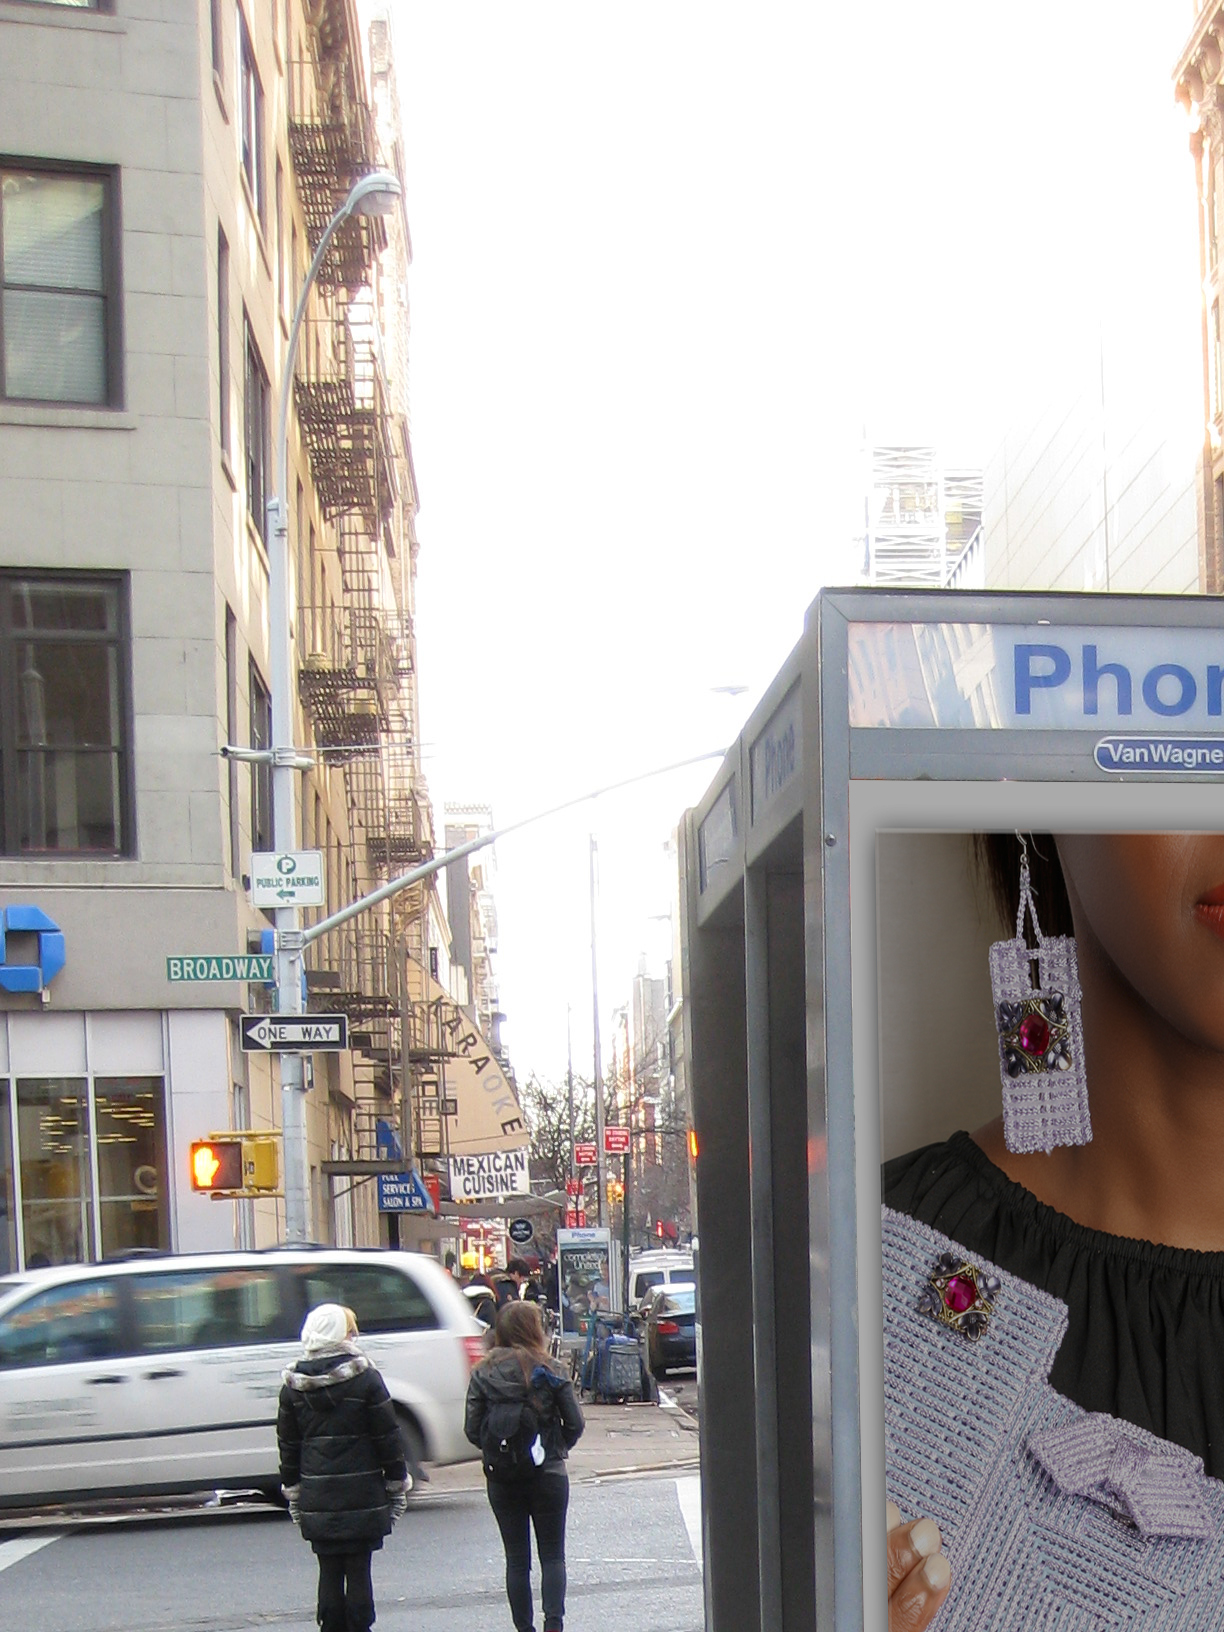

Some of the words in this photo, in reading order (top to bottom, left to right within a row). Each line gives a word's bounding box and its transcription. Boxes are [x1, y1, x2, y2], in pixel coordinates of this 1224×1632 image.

[256, 876, 284, 889] PUBLIC
[285, 875, 320, 888] PARKING
[169, 957, 272, 981] BROADWAY
[257, 1026, 287, 1041] ONE
[301, 1026, 333, 1041] WAY
[427, 995, 523, 1135] KARAOKE
[453, 1152, 525, 1177] MEXICAN
[462, 1172, 518, 1196] CUISINE
[382, 1196, 404, 1208] SALON
[411, 1195, 424, 1208] SPA
[571, 1230, 596, 1239] Phone
